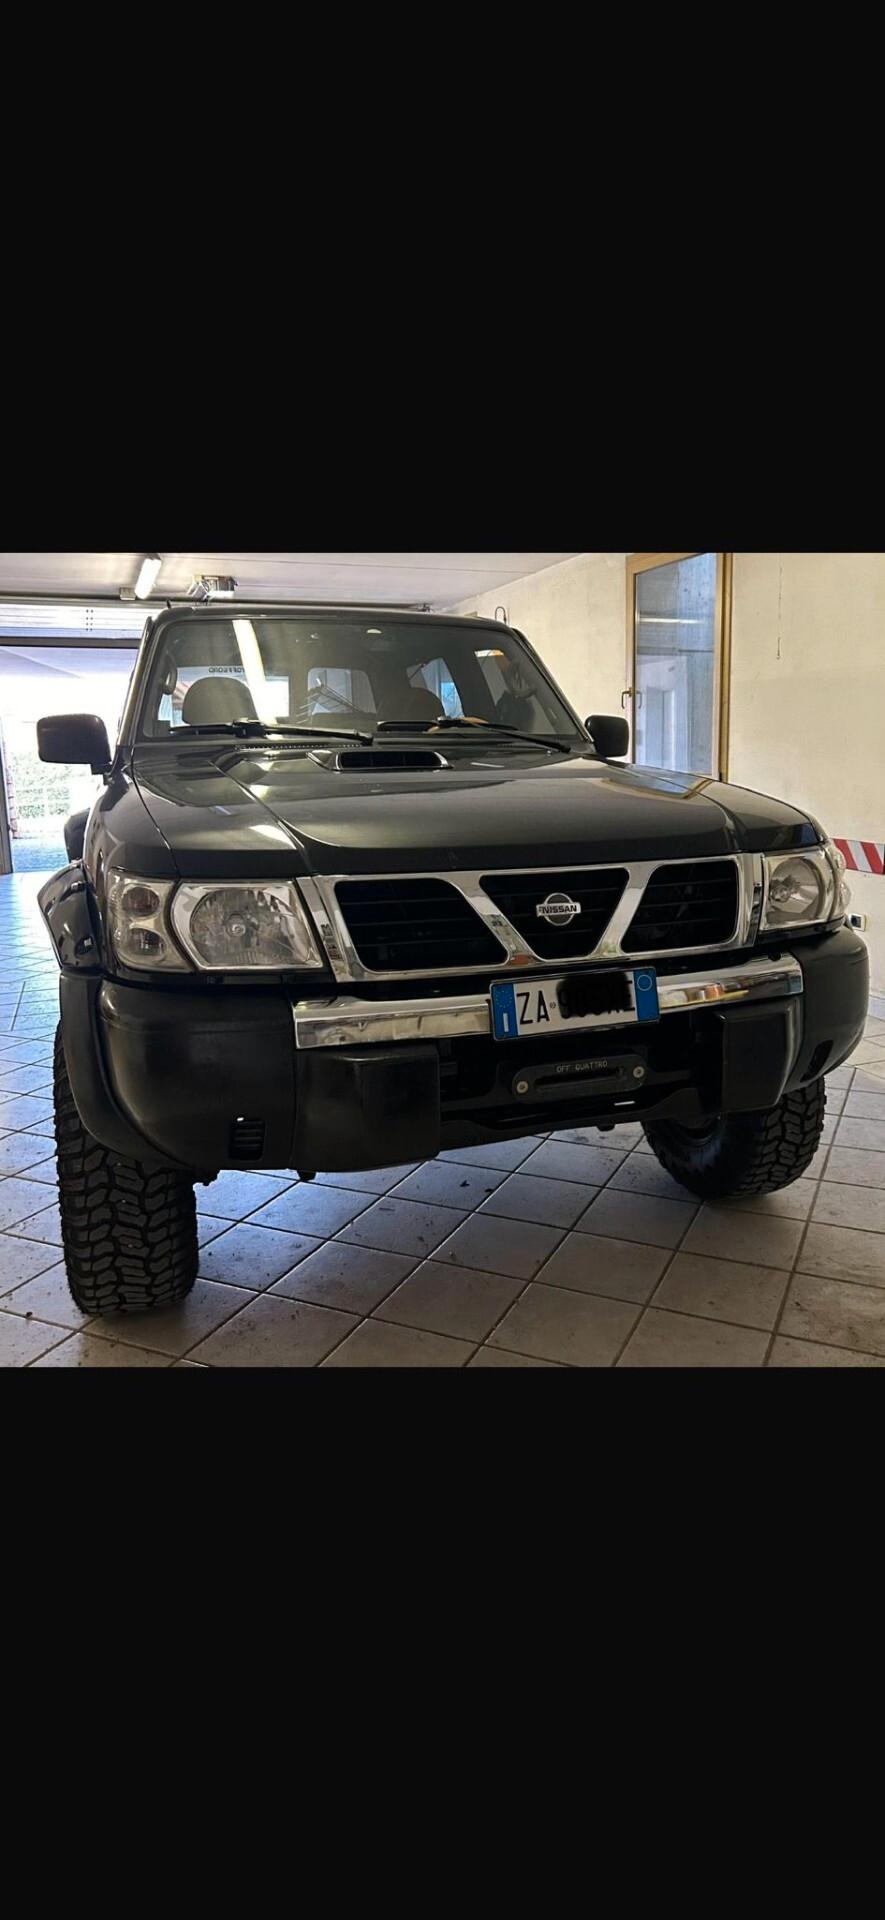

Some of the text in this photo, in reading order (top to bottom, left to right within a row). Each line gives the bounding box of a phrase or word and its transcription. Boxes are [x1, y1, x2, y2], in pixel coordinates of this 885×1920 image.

[542, 904, 577, 914] NISSAN
[516, 990, 550, 1025] ZA
[556, 1060, 608, 1073] OFF QUATTRO
